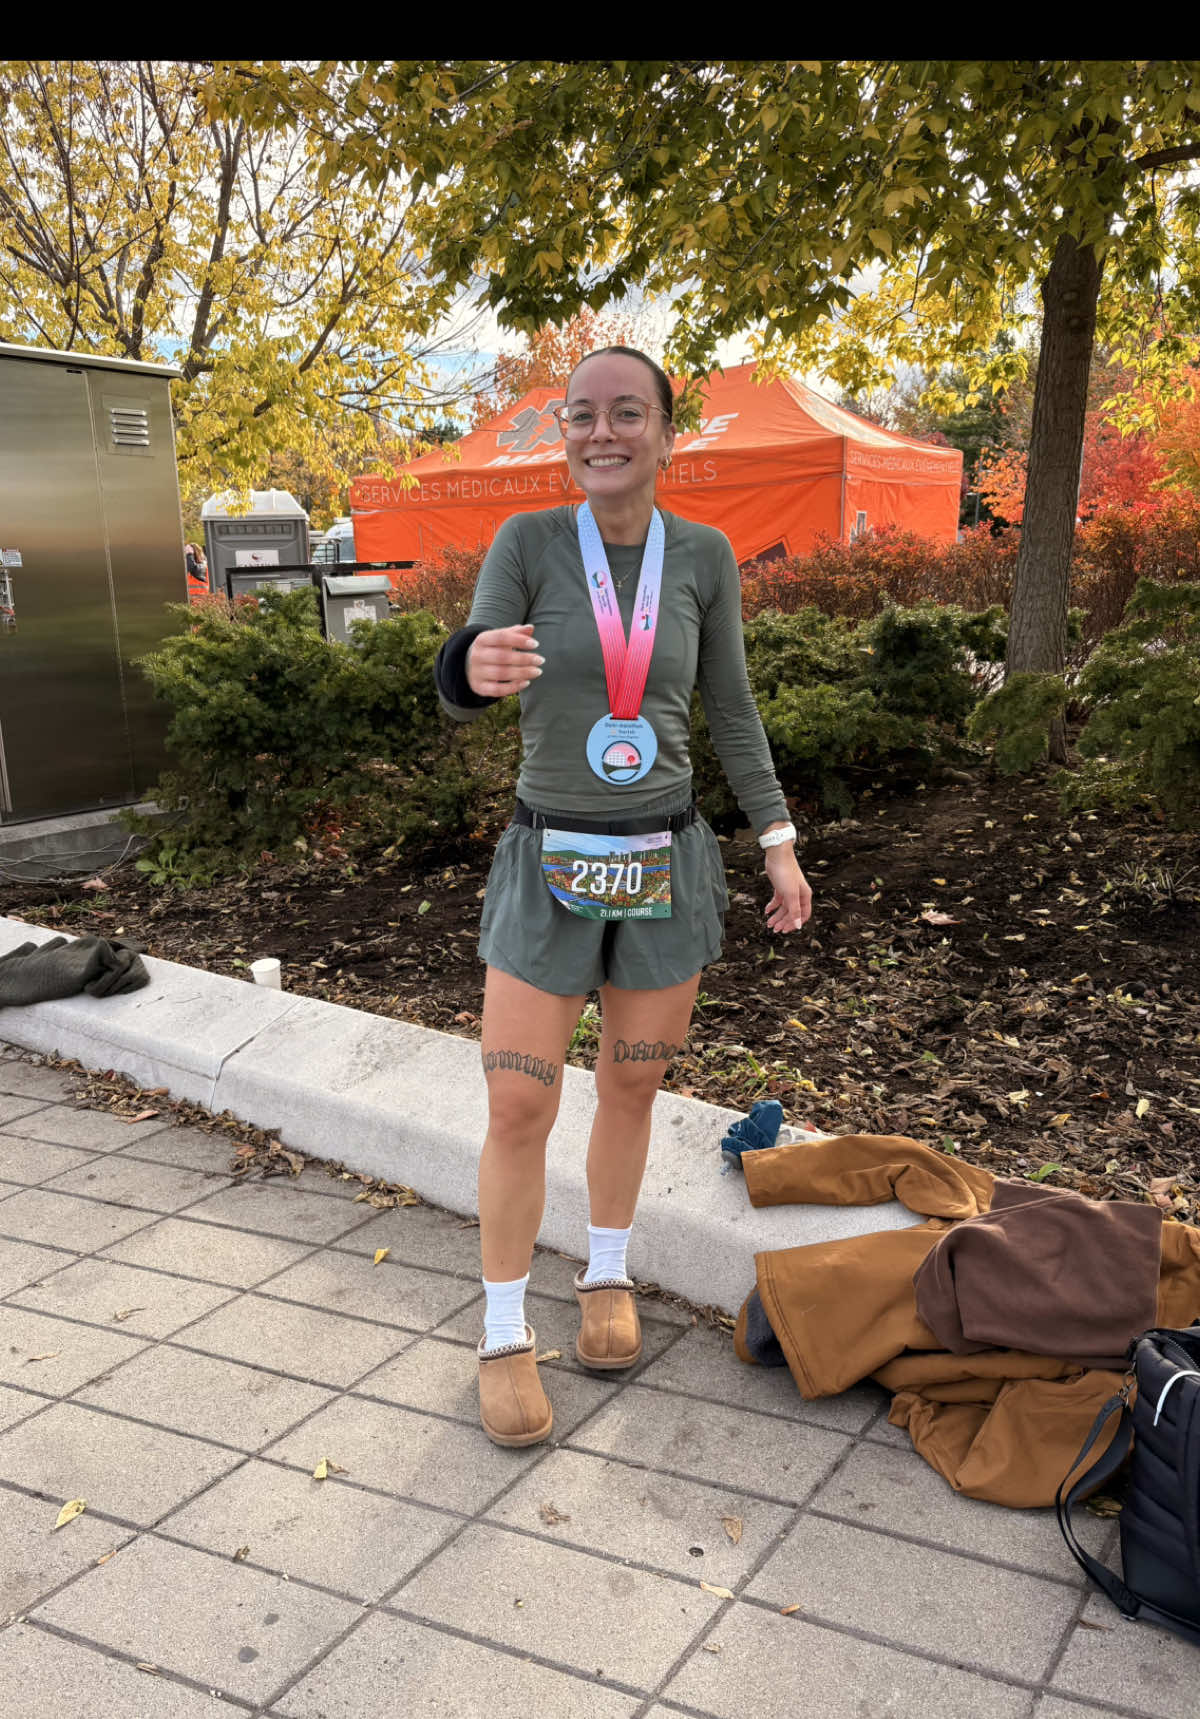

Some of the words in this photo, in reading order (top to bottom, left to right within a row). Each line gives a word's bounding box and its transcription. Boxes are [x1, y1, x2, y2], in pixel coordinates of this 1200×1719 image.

[361, 482, 442, 505] SERVICES
[447, 474, 541, 500] MÉDICAUX
[571, 860, 643, 896] 2370
[627, 906, 654, 918] COURSE
